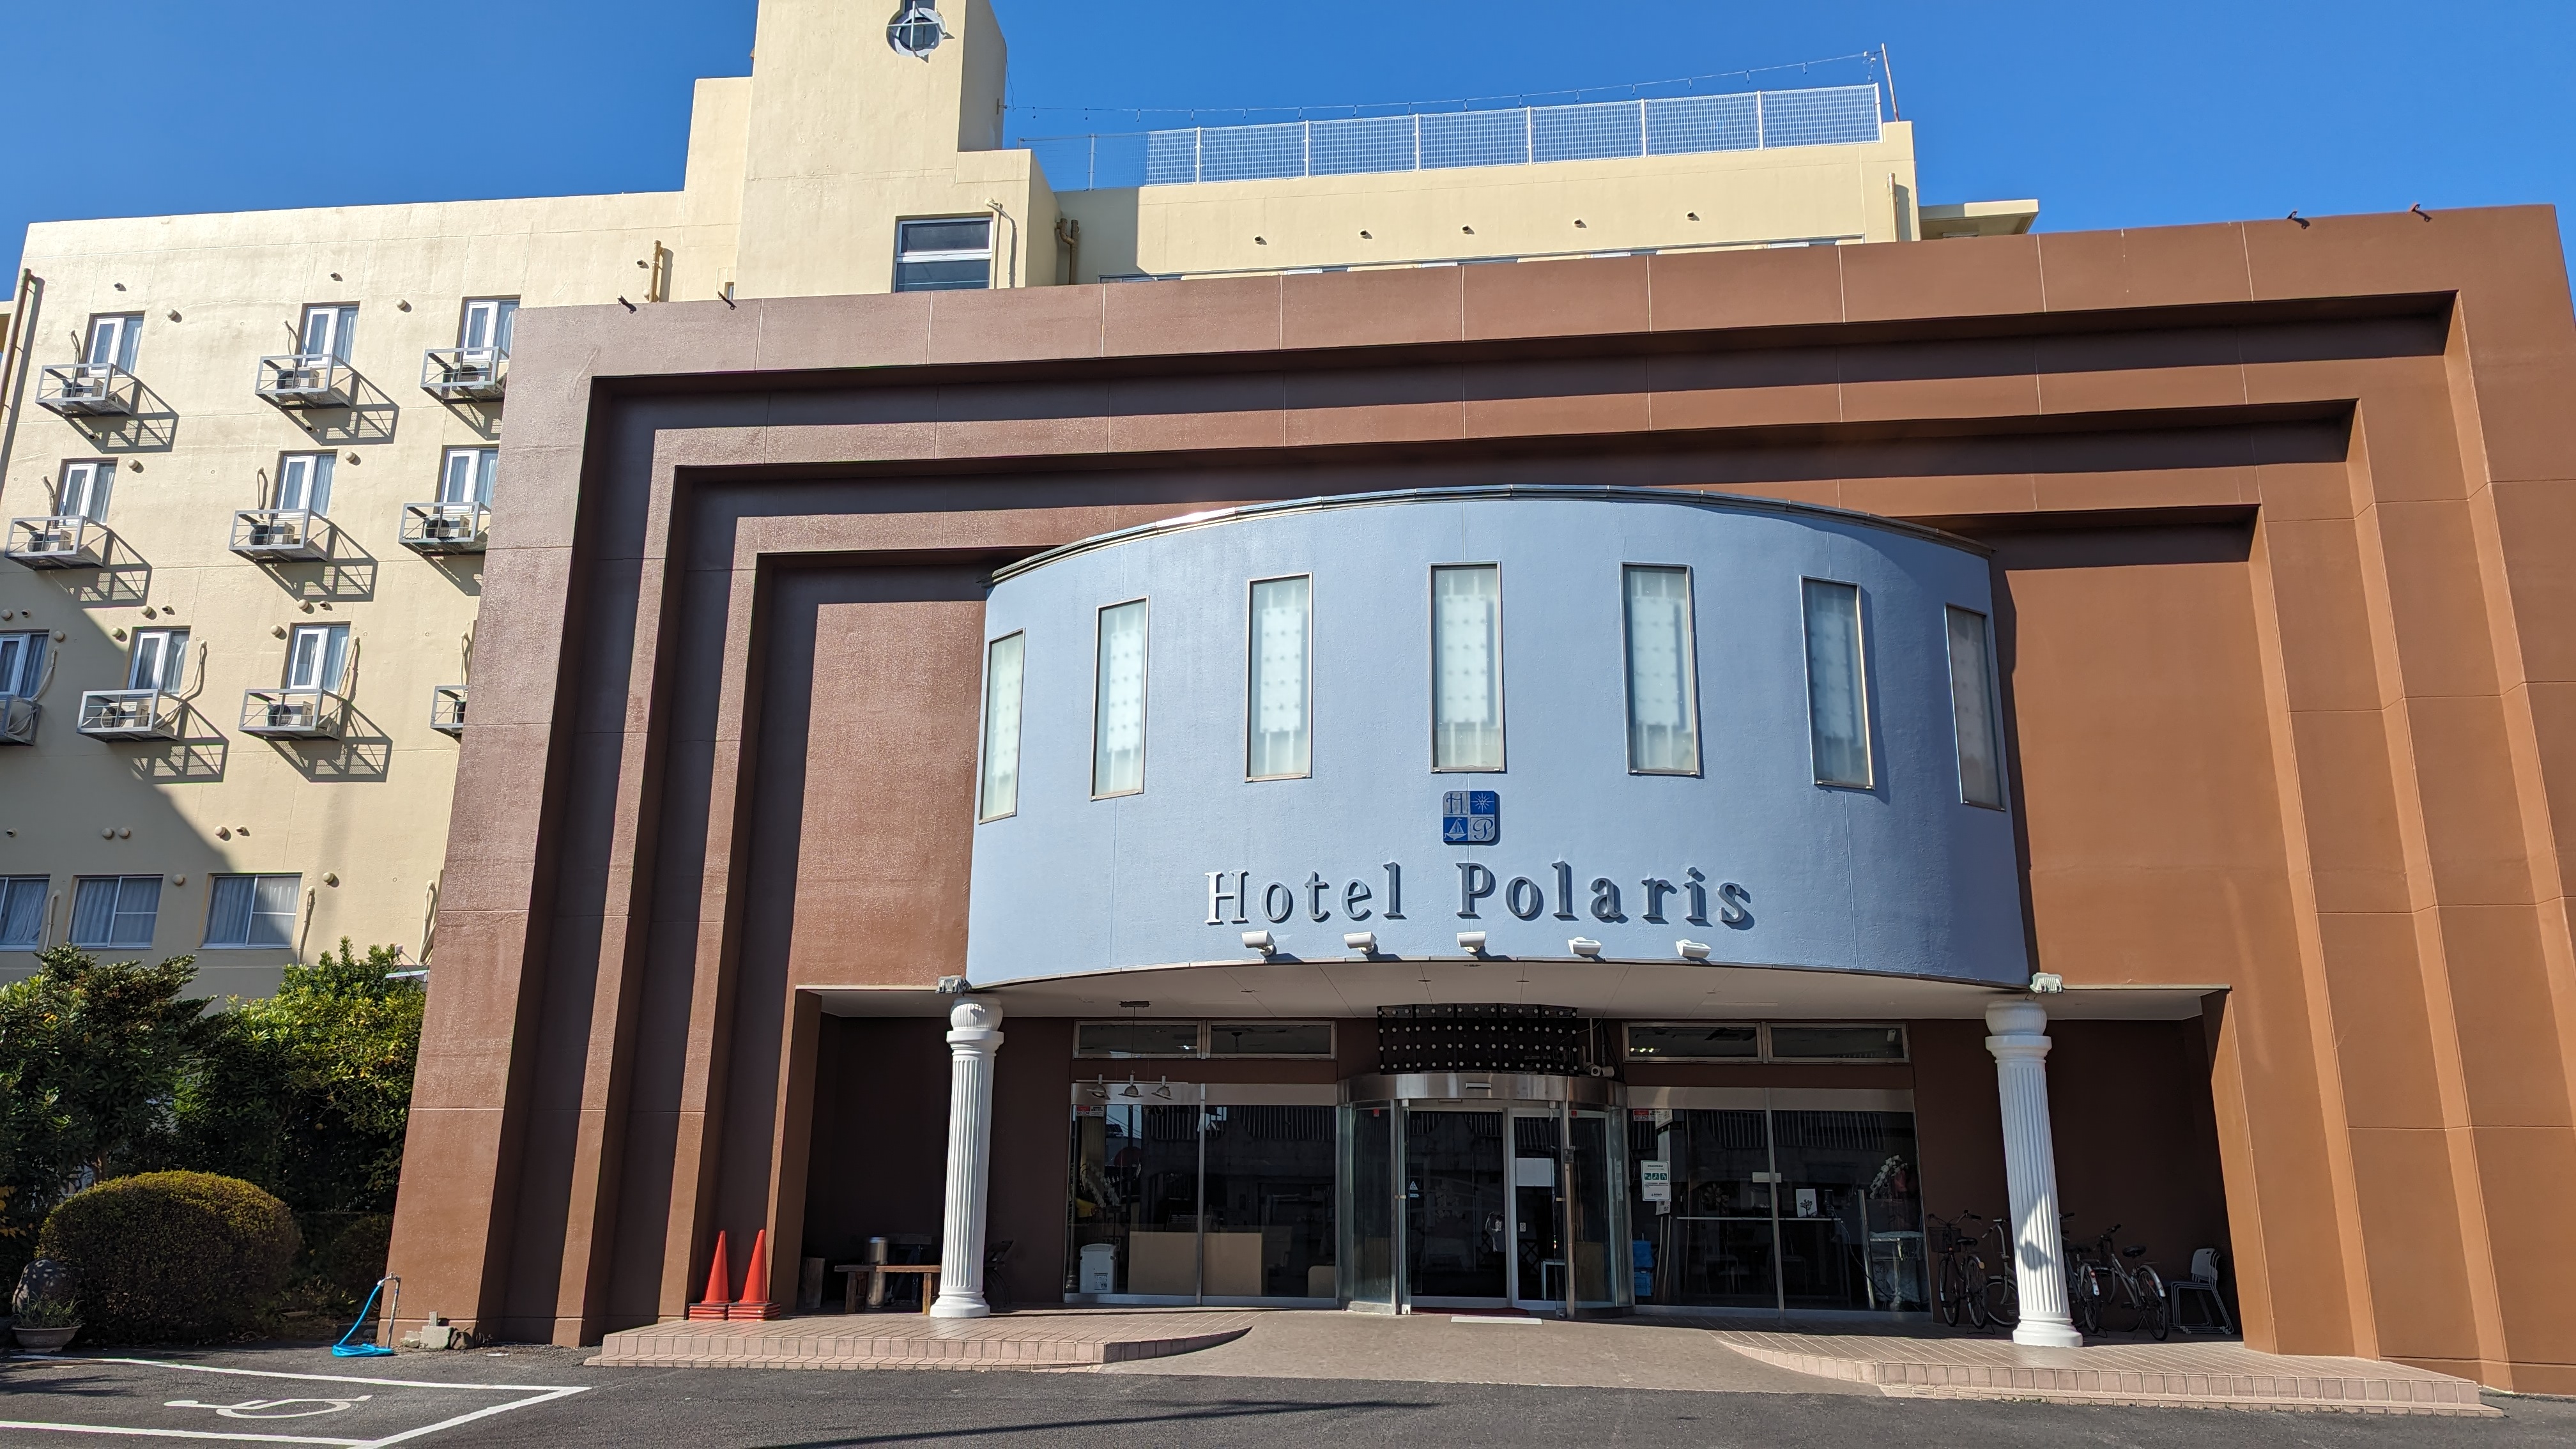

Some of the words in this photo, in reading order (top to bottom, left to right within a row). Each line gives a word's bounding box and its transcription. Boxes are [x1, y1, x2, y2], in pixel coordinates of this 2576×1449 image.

[1446, 793, 1463, 814] H
[1473, 818, 1493, 840] P
[1204, 862, 1404, 924] Hotel
[1455, 861, 1748, 924] Polaris
